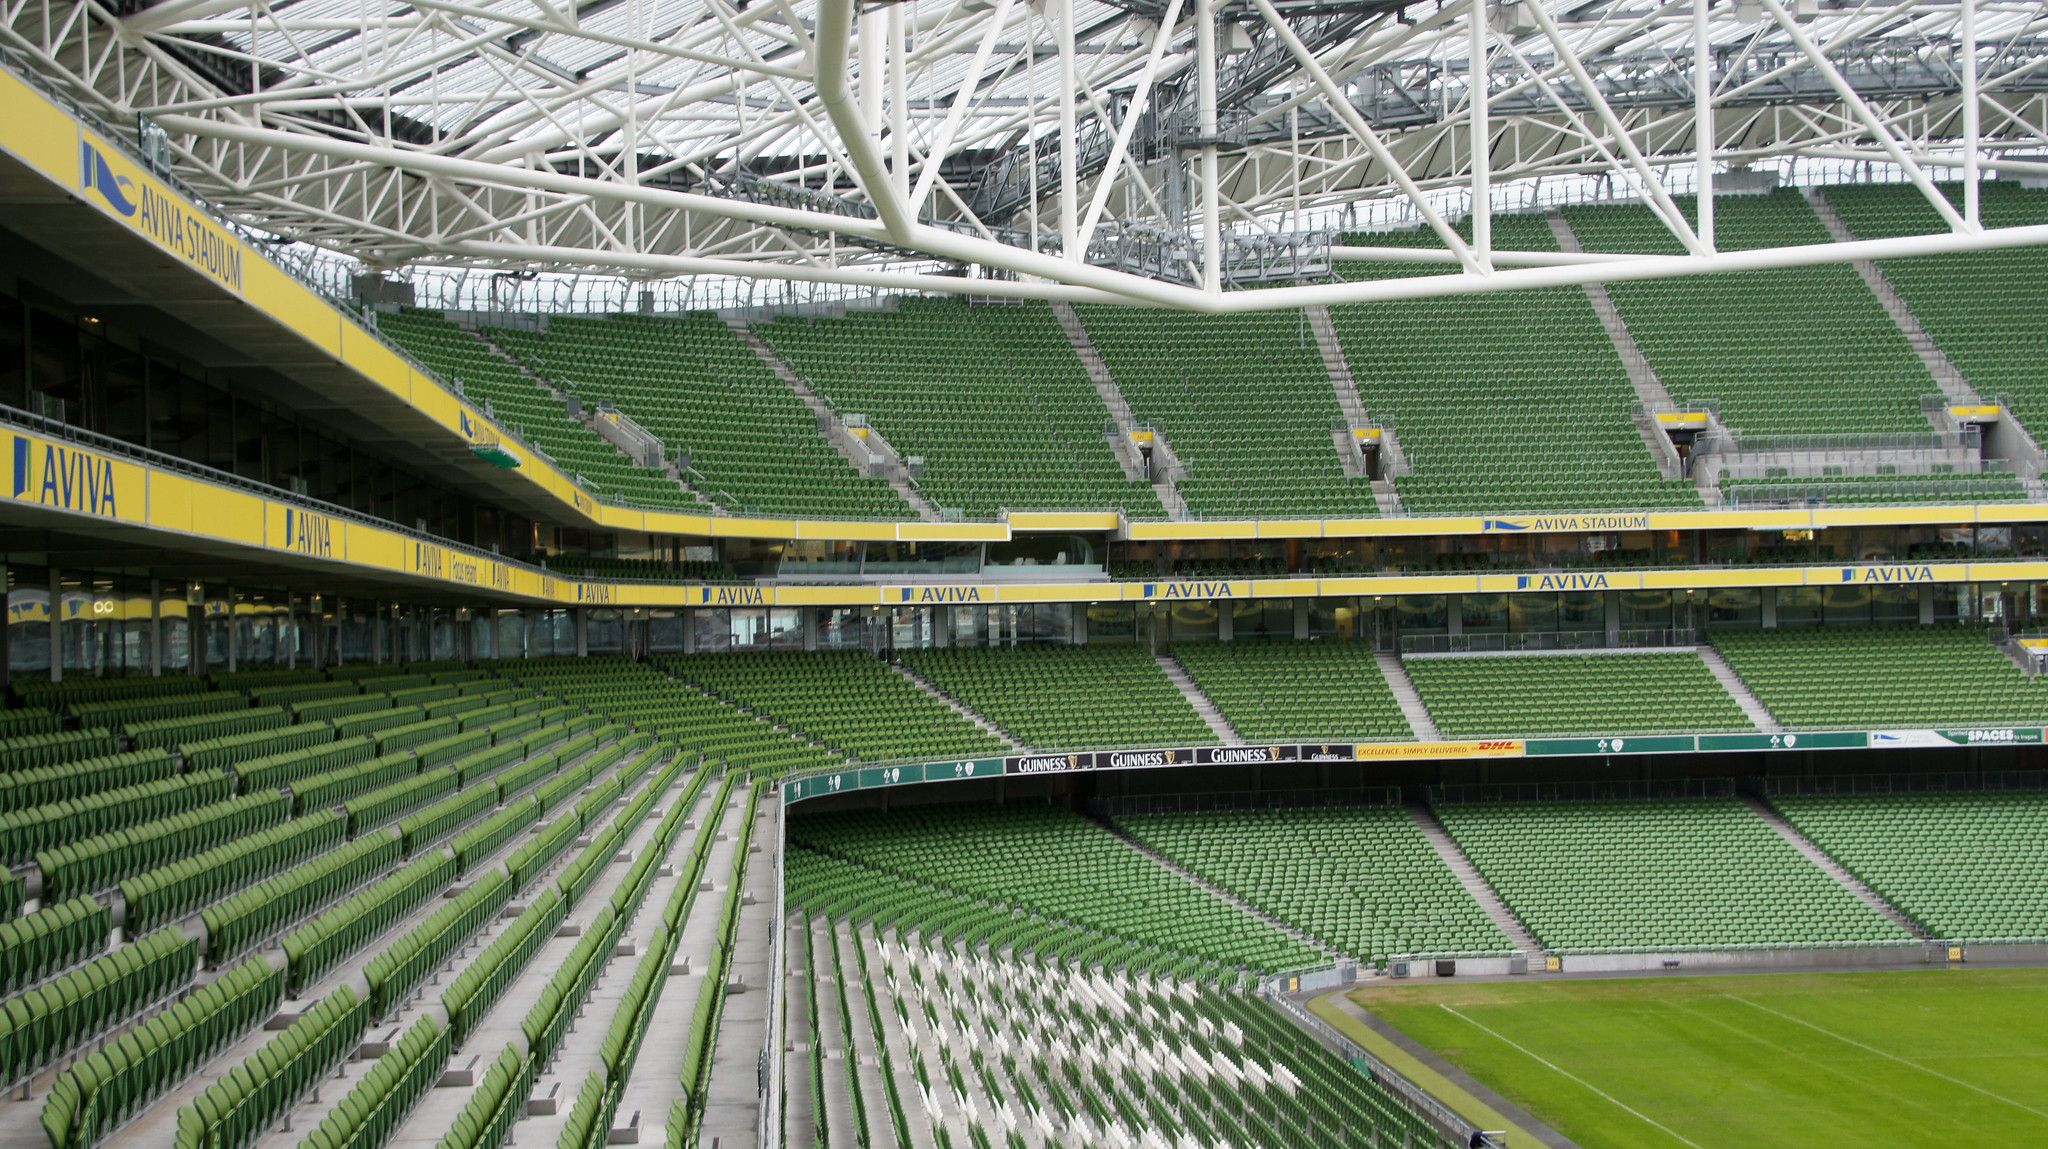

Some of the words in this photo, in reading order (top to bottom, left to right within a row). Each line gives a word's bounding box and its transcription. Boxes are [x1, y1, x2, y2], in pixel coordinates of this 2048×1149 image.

[141, 184, 186, 253] AVIVA
[187, 215, 241, 290] STADIUM
[41, 444, 116, 517] AVIVA
[1534, 518, 1578, 530] AVIVA
[1582, 516, 1647, 528] STADIUM
[298, 512, 332, 557] AVIVA
[422, 543, 443, 578] AVIVA
[1539, 574, 1609, 589] AVIVA
[1864, 566, 1934, 582] AVIVA
[586, 584, 610, 603] AVIVA
[717, 586, 764, 604] AVIVA
[921, 586, 980, 602] AVIVA
[1165, 582, 1233, 598] AVIVA
[1968, 730, 2013, 741] SPACES
[1479, 742, 1515, 750] DHL
[1110, 752, 1163, 767] GUINNESS
[1211, 748, 1267, 763] GUINNESS
[1311, 752, 1339, 760] GUINNESS
[1018, 757, 1067, 773] GUINNESS
